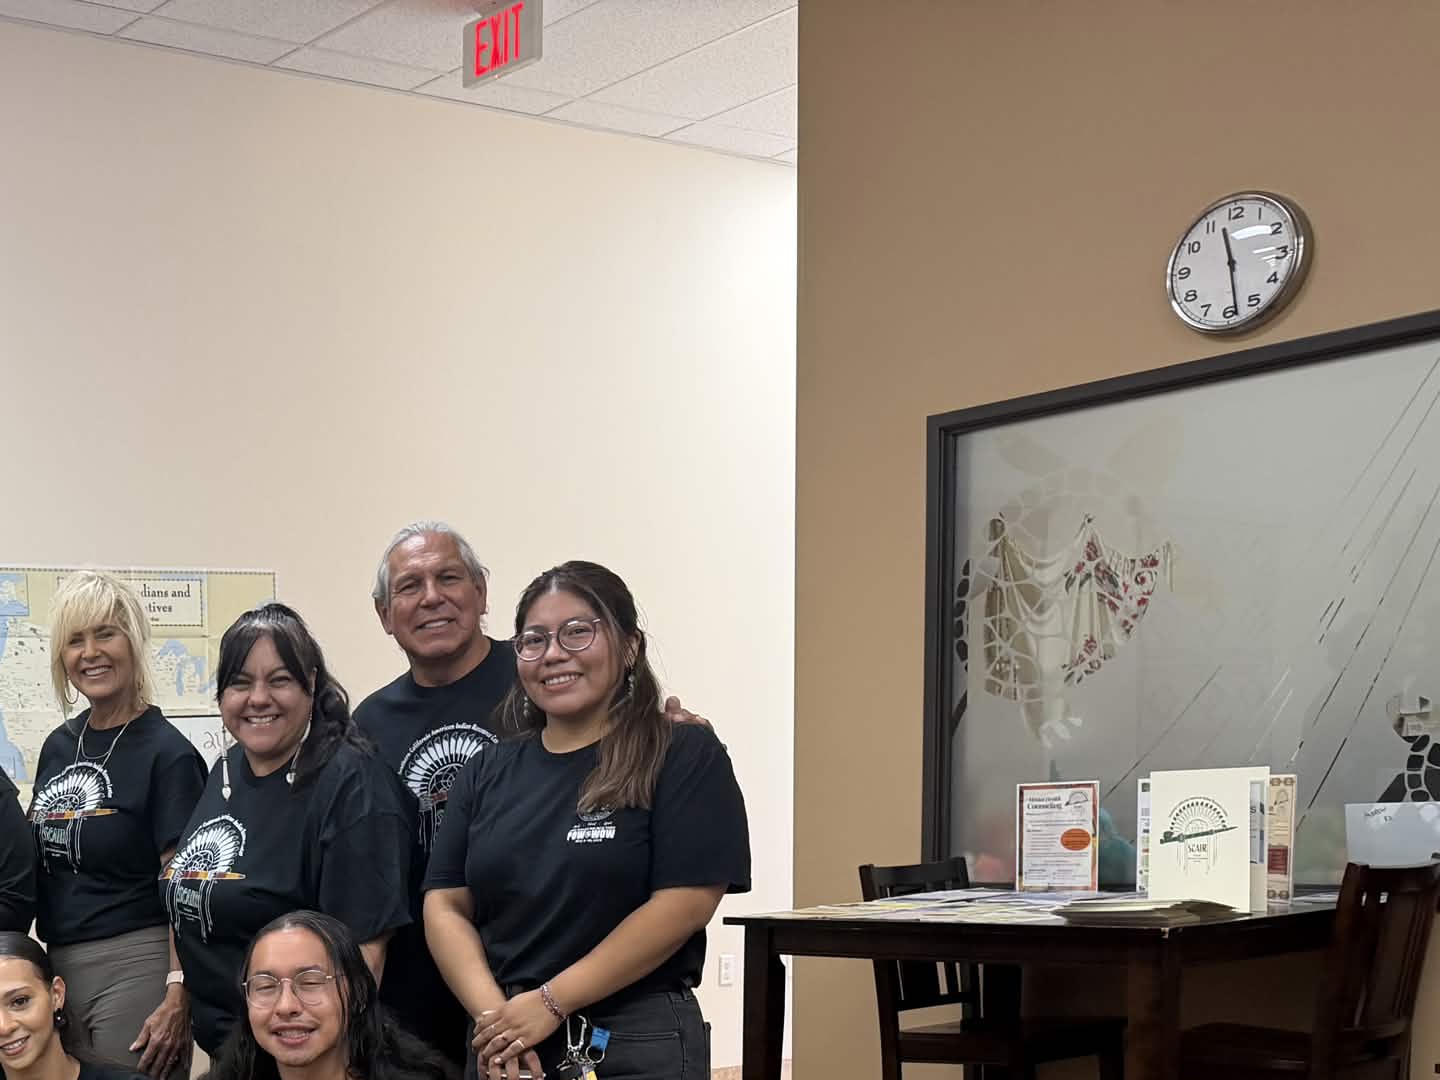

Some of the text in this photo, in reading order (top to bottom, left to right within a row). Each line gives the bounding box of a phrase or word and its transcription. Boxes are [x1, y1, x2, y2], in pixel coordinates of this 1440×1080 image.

[474, 1, 525, 78] EXIT
[1228, 206, 1245, 221] 12
[1206, 220, 1216, 234] 11
[1270, 222, 1283, 235] 2
[1187, 240, 1201, 255] 10
[1275, 245, 1289, 260] 3
[1177, 267, 1192, 280] 9
[1266, 271, 1279, 284] 4
[1183, 289, 1198, 303] 8
[1248, 294, 1261, 307] 5
[1200, 304, 1212, 317] 7
[1222, 305, 1236, 319] 6
[140, 583, 191, 598] dians and
[147, 601, 173, 613] tives
